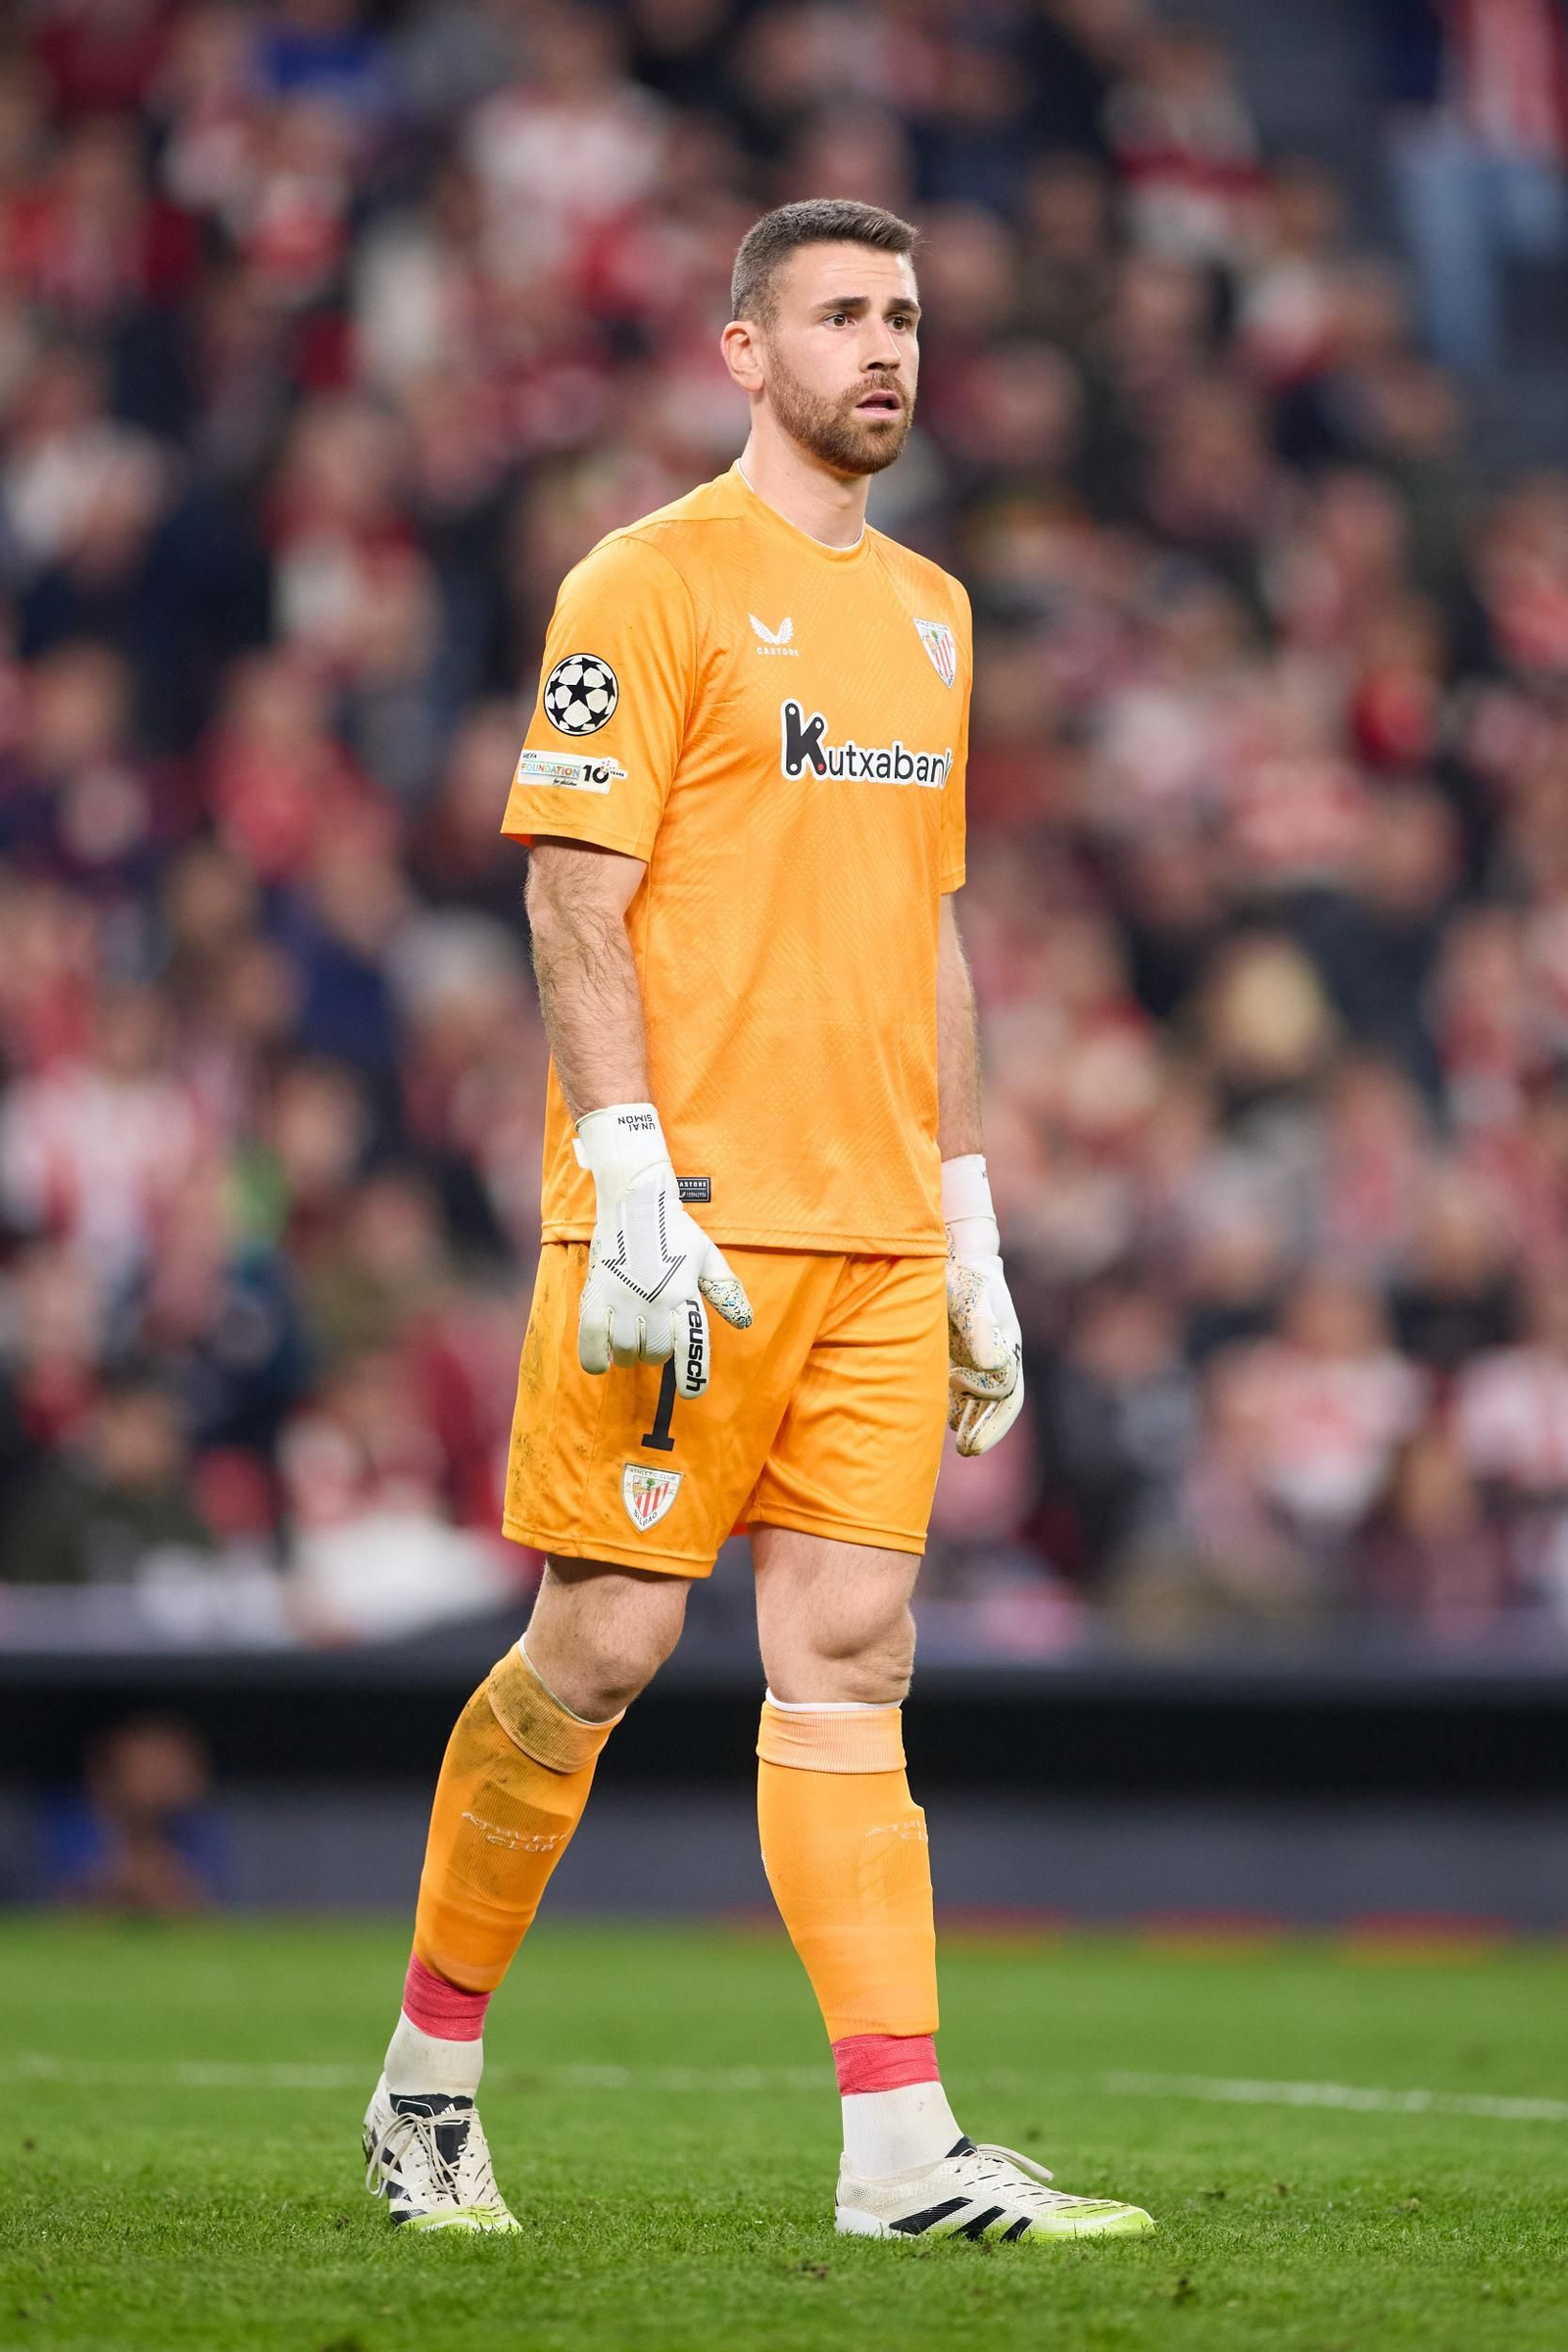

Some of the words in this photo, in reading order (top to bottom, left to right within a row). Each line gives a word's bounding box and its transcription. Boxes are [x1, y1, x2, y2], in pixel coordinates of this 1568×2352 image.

[756, 646, 800, 658] CASTORE
[520, 761, 581, 778] FOUNDATION
[582, 764, 610, 784] 10
[628, 1122, 656, 1132] UNAI
[685, 1298, 708, 1393] reusch
[630, 1467, 658, 1479] ATHLETIC
[633, 1508, 658, 1527] BILBAO
